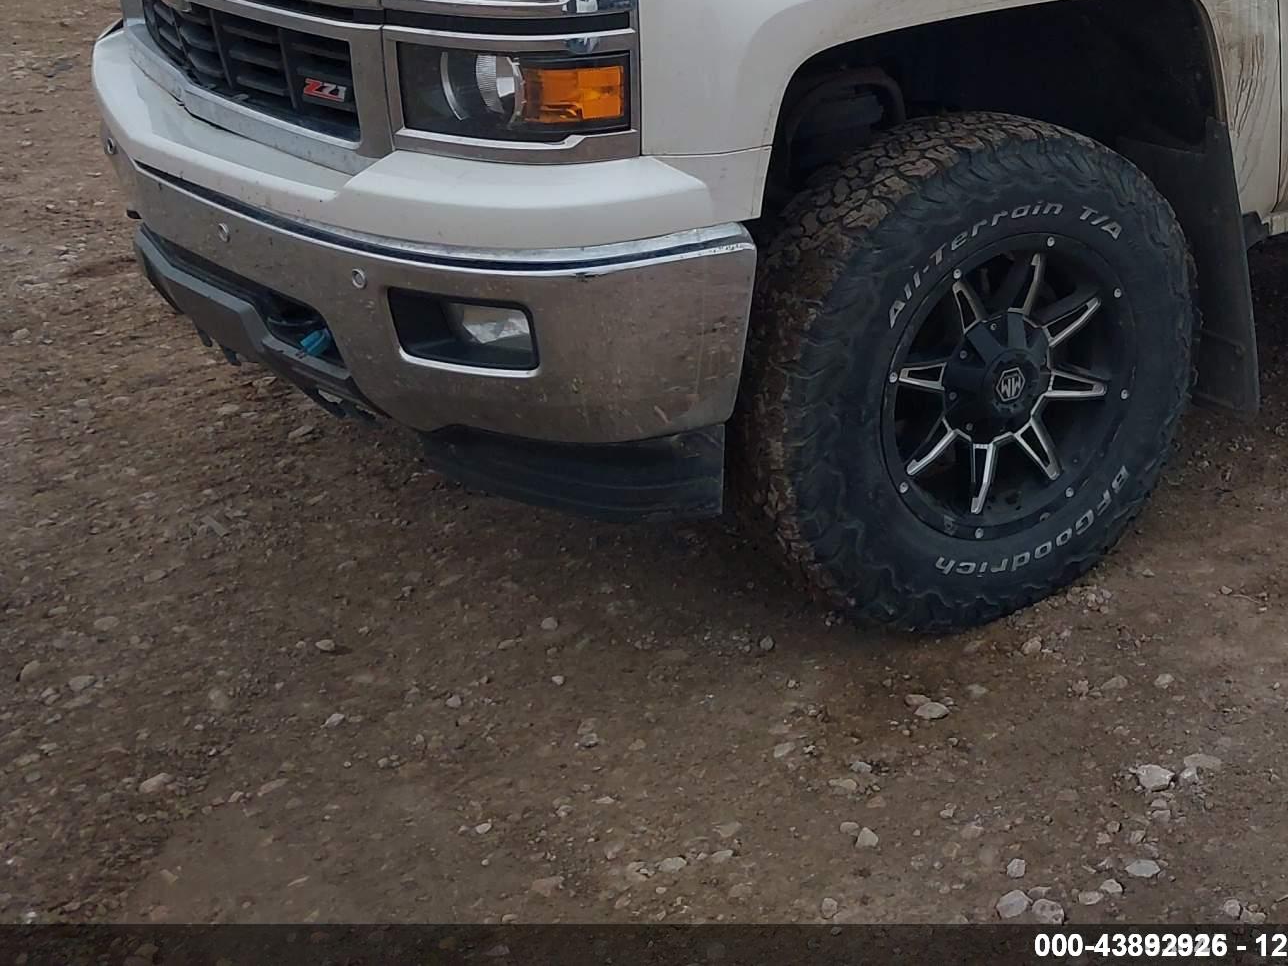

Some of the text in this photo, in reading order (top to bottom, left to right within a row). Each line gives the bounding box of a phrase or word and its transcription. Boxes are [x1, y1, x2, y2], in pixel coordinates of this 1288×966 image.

[304, 77, 347, 102] Z71
[888, 200, 1123, 329] All-Terrain T/A
[935, 465, 1131, 578] BFGoodrich
